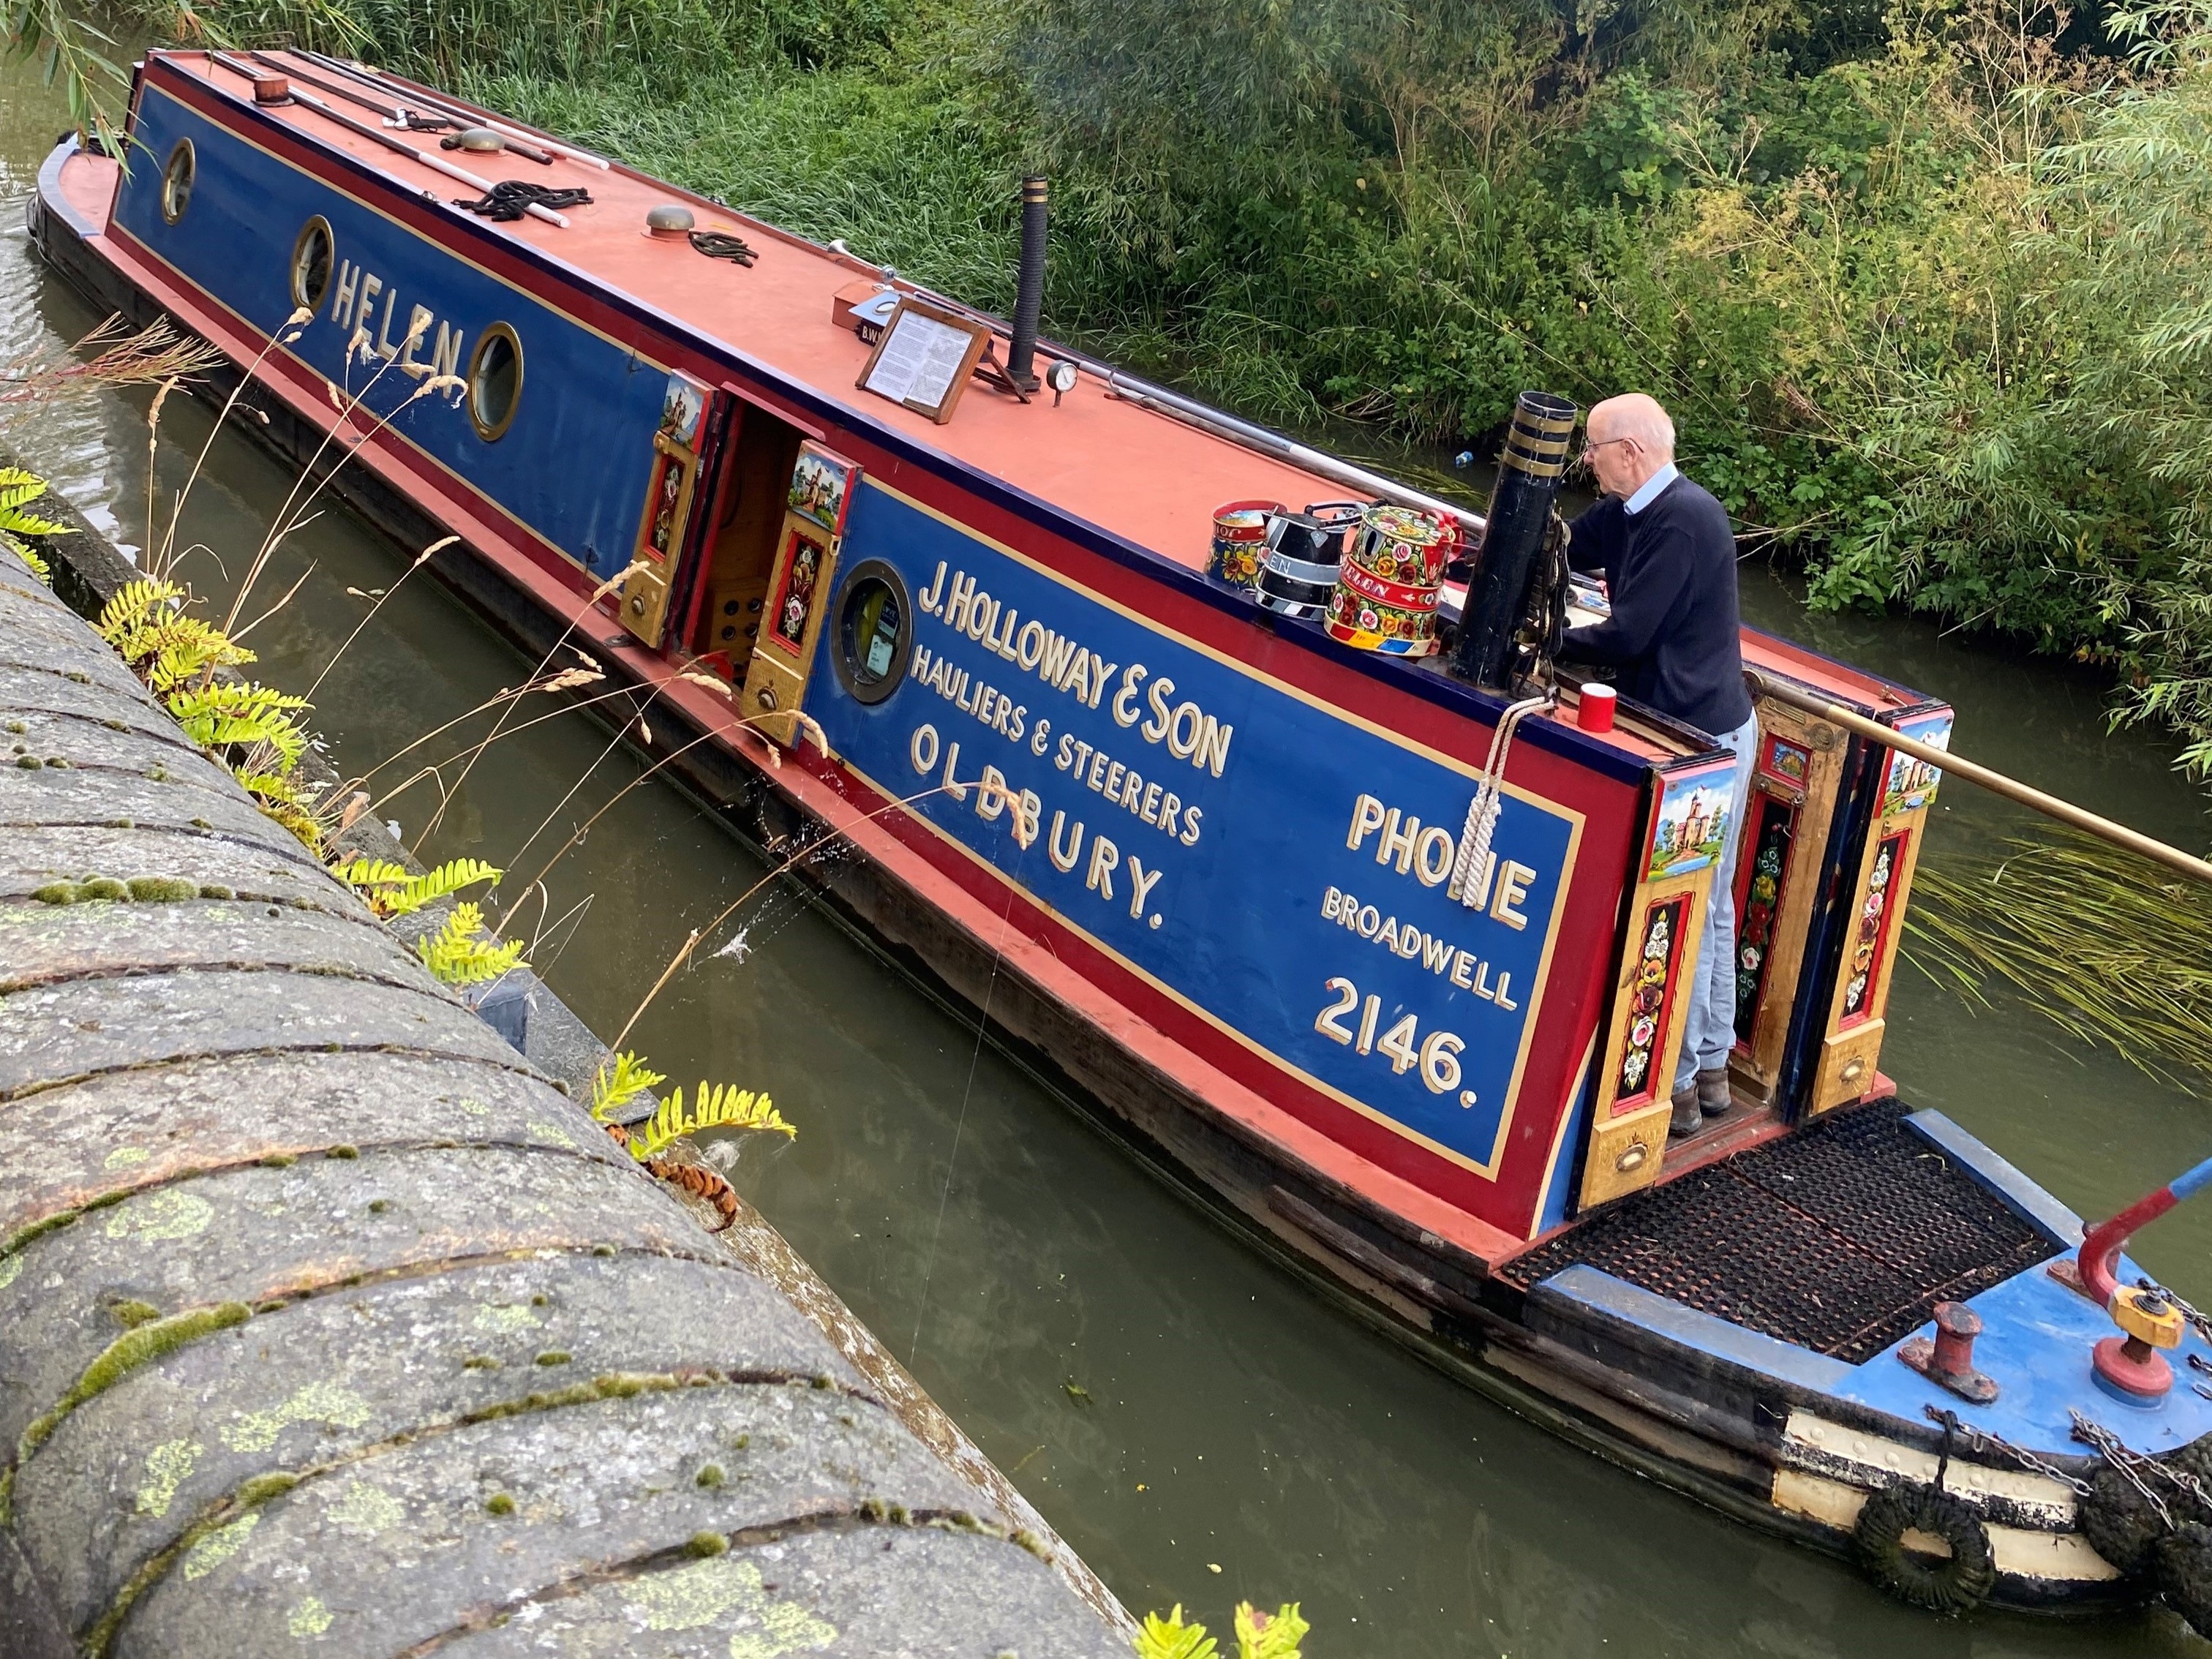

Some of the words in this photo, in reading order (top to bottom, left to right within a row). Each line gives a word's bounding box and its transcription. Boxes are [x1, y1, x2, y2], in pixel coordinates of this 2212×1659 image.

[331, 259, 464, 399] HELEN
[911, 644, 1028, 743] HAULIERS
[1031, 718, 1051, 756] &
[1054, 733, 1203, 846] STEERERS
[1321, 885, 1518, 1011] BROADWELL
[1314, 977, 1478, 1109] 2146.
